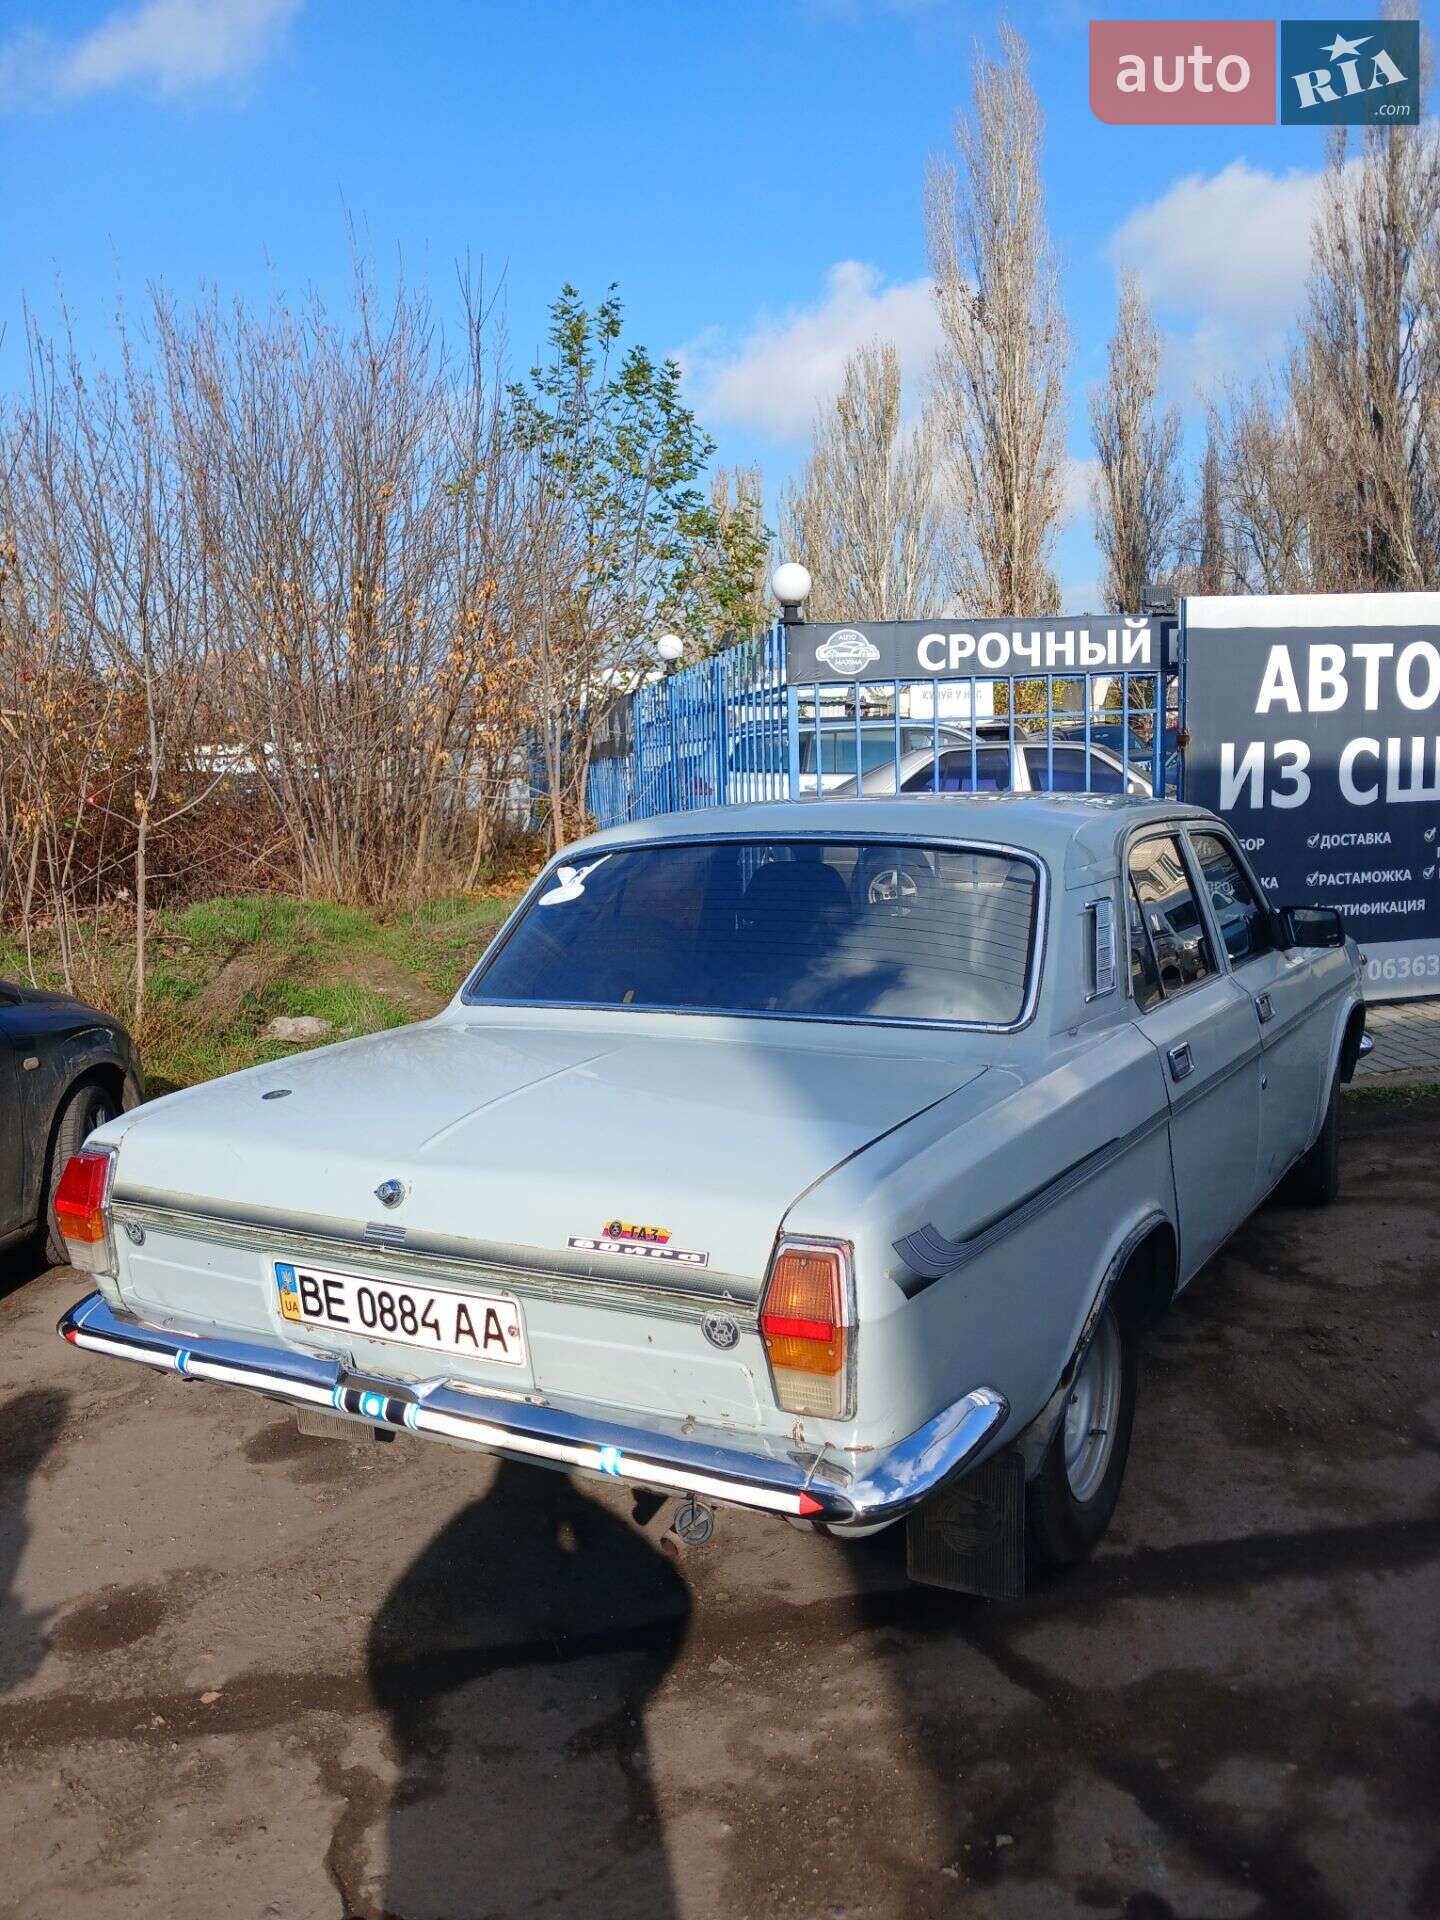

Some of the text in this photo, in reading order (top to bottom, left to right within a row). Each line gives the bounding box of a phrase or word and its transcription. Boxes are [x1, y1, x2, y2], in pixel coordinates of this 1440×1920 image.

[917, 617, 1151, 671] СРОЧНЫЙ
[1254, 641, 1440, 713] АВТО
[1219, 739, 1311, 811] ИЗ
[1320, 831, 1392, 850] ДОСТАВКА
[1318, 869, 1412, 886] РАСТАМОЖКА
[630, 1225, 659, 1241] ГАЗ
[284, 1302, 299, 1313] UA
[298, 1274, 509, 1354] BE 0884 AA
